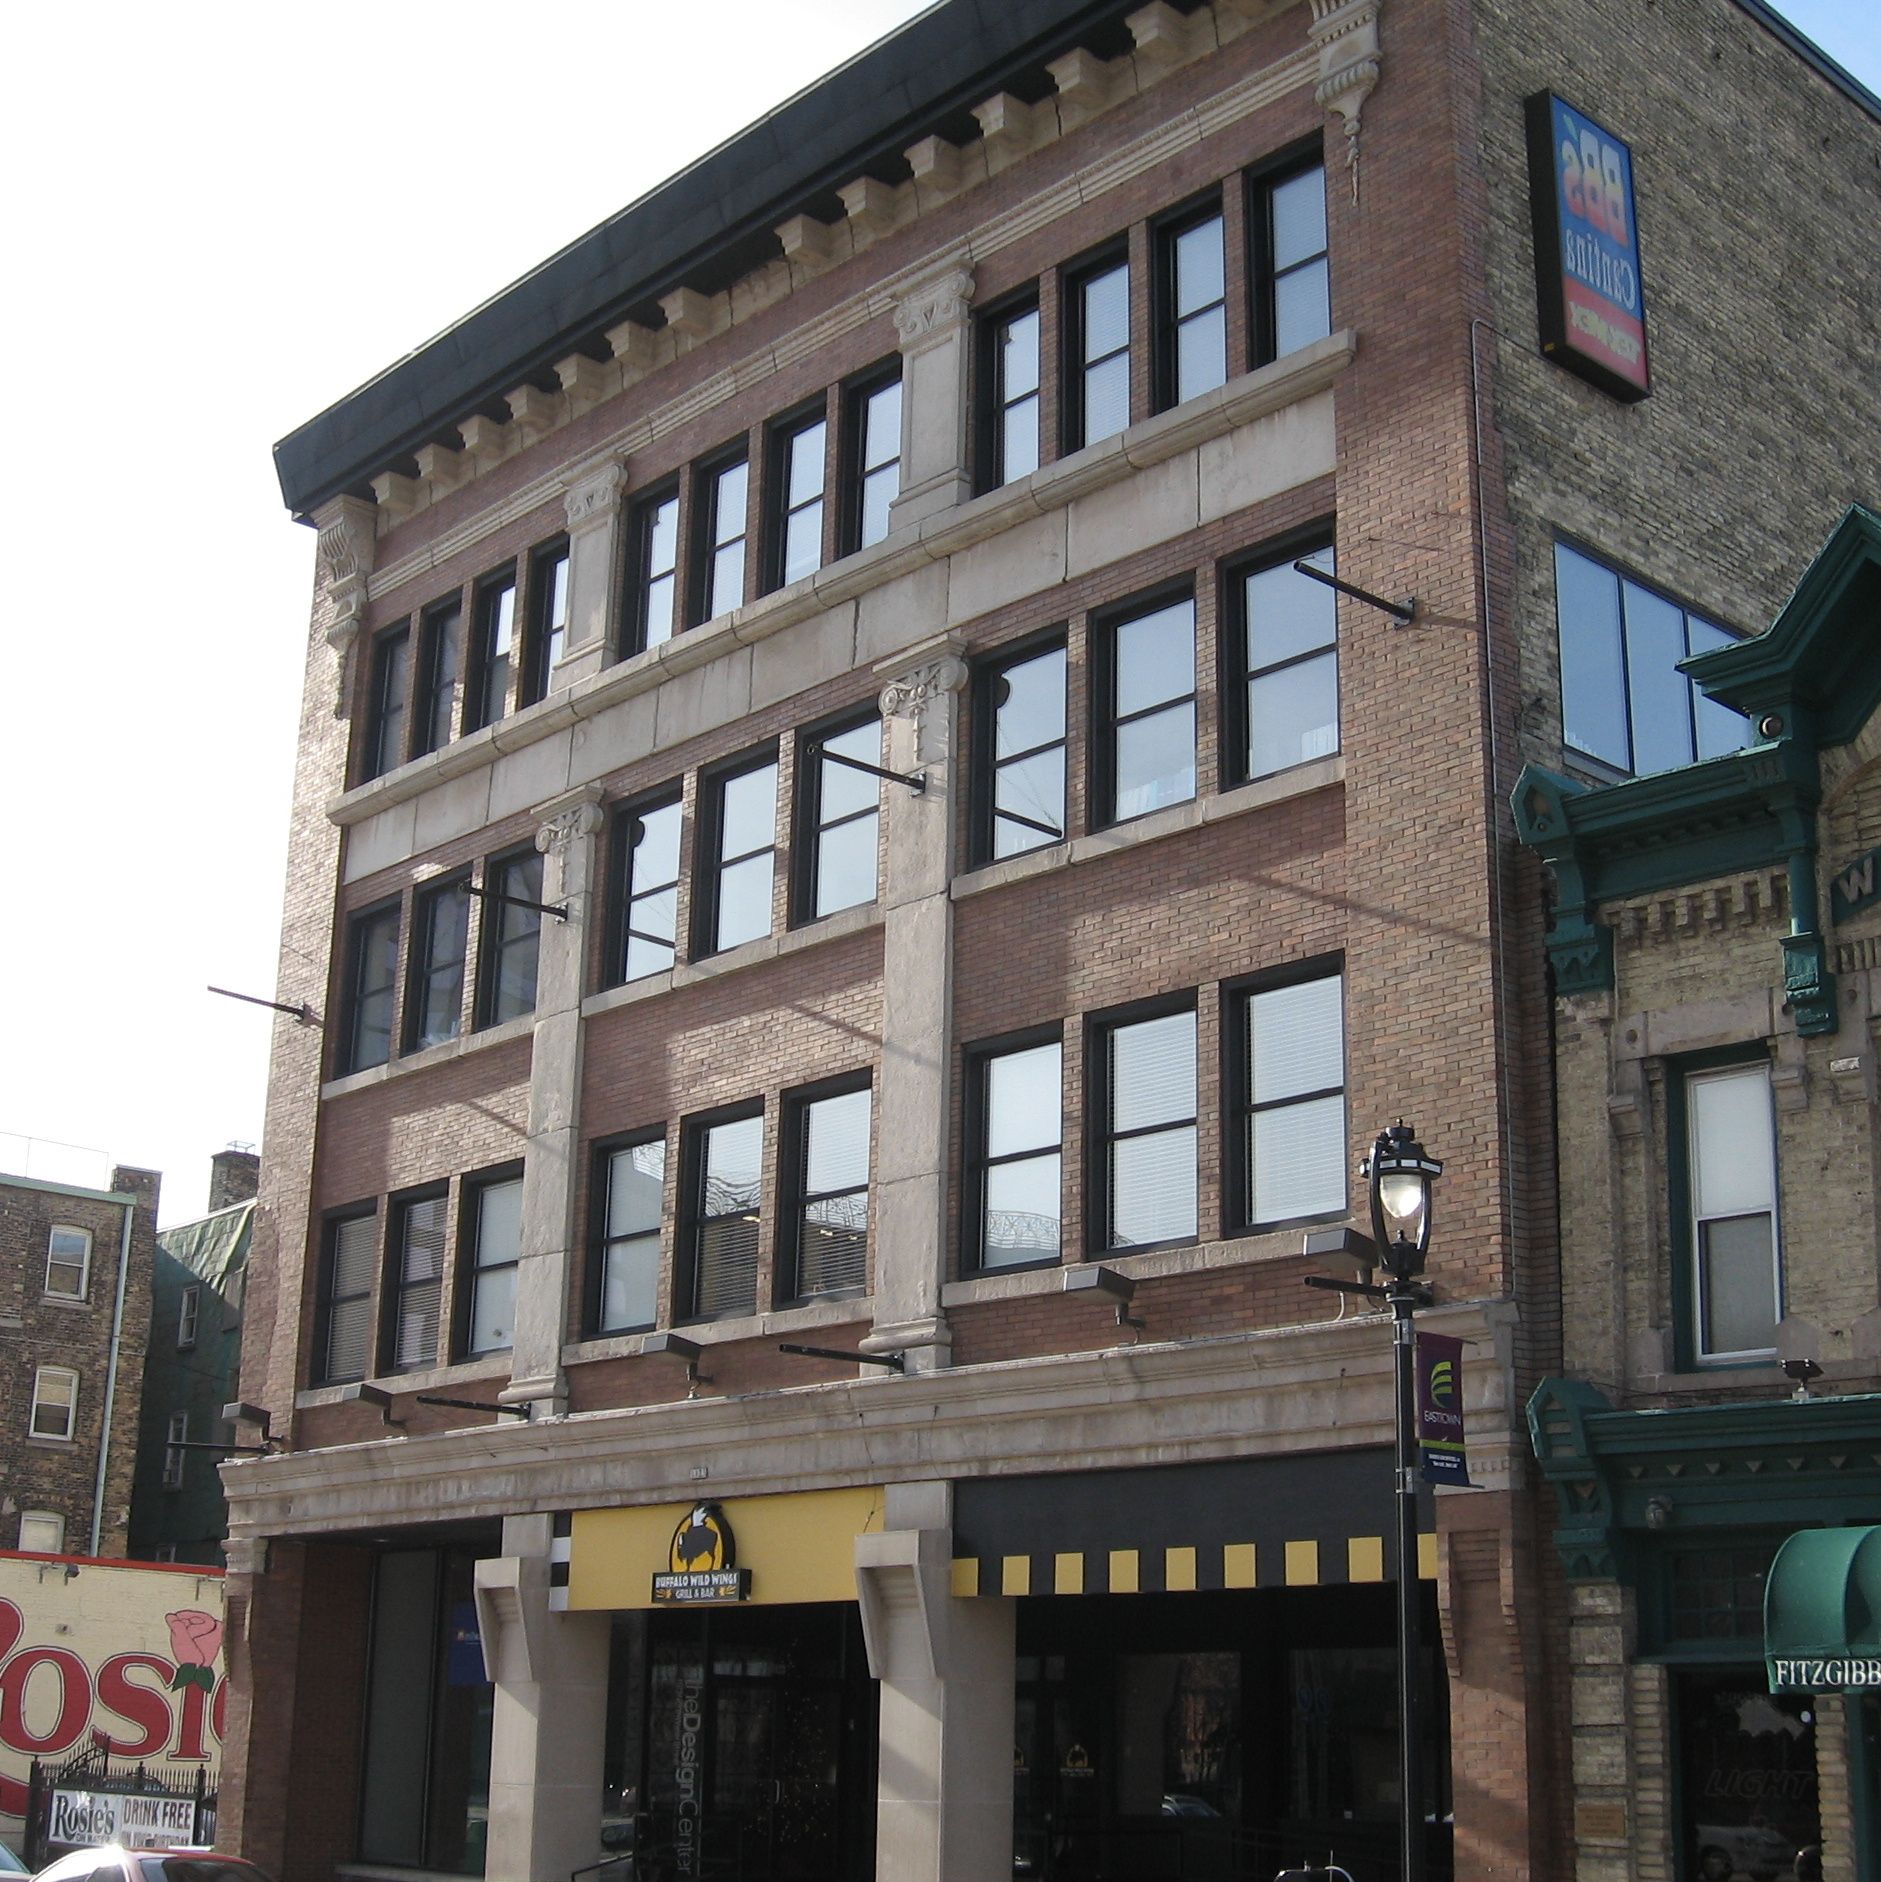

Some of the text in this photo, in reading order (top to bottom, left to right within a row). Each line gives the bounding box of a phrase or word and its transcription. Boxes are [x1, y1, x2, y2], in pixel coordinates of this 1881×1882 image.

[655, 1572, 738, 1588] BUFFALO WILD WINGS
[693, 1589, 699, 1598] &
[700, 1587, 715, 1598] BAR
[53, 1795, 115, 1842] Rosie's
[124, 1798, 191, 1830] DRINK FREE
